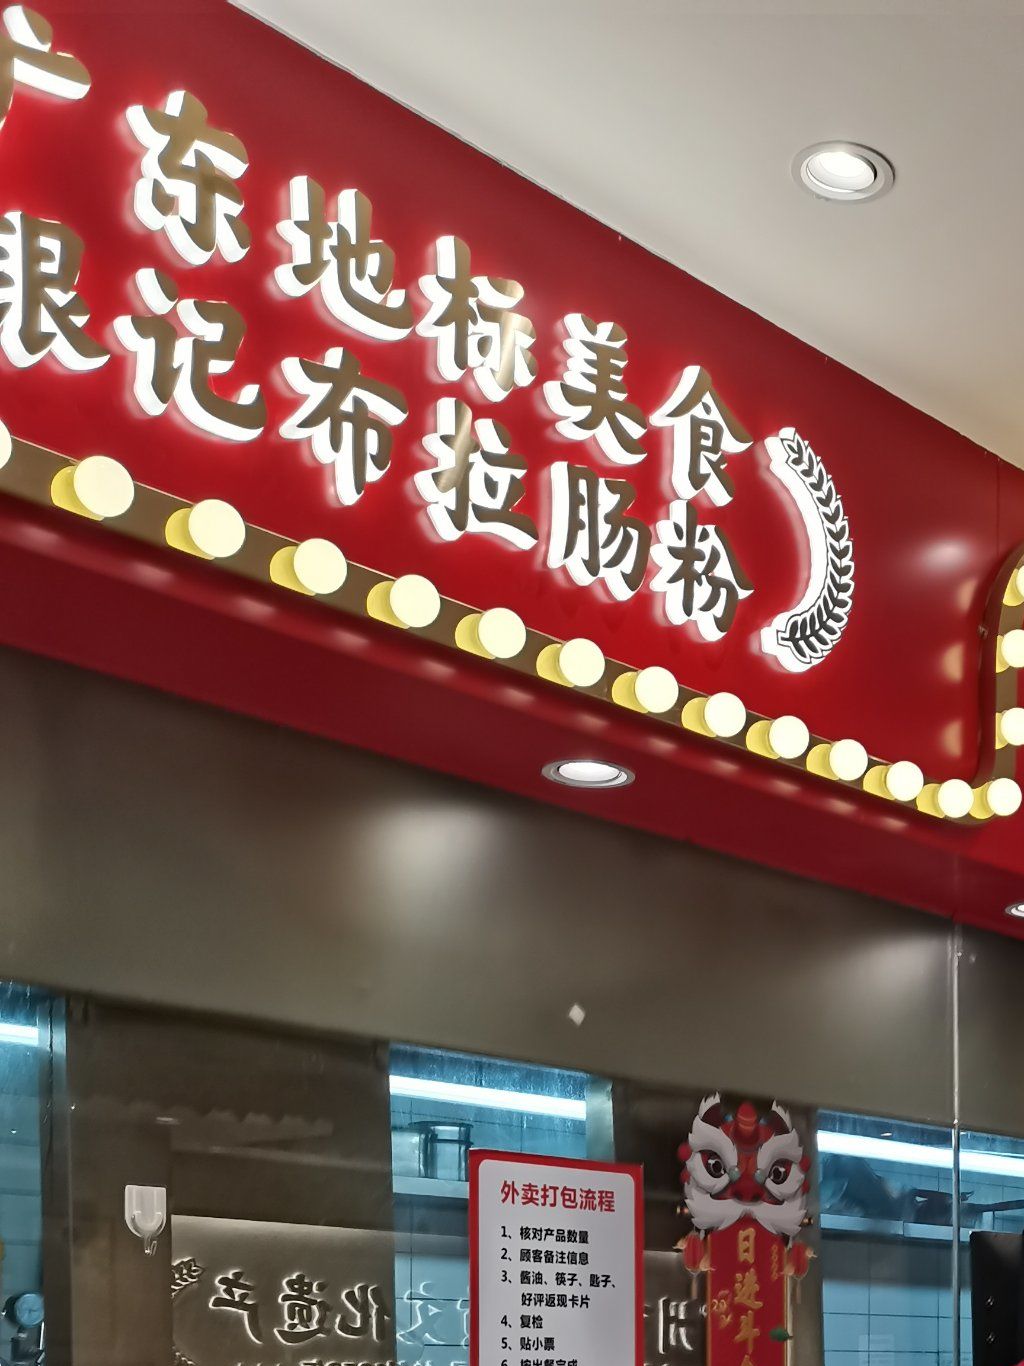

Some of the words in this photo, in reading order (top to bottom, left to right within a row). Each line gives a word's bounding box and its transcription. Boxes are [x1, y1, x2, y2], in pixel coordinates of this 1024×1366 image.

[500, 1180, 616, 1213] 外卖打包流程
[521, 1292, 591, 1309] 好评返现卡片
